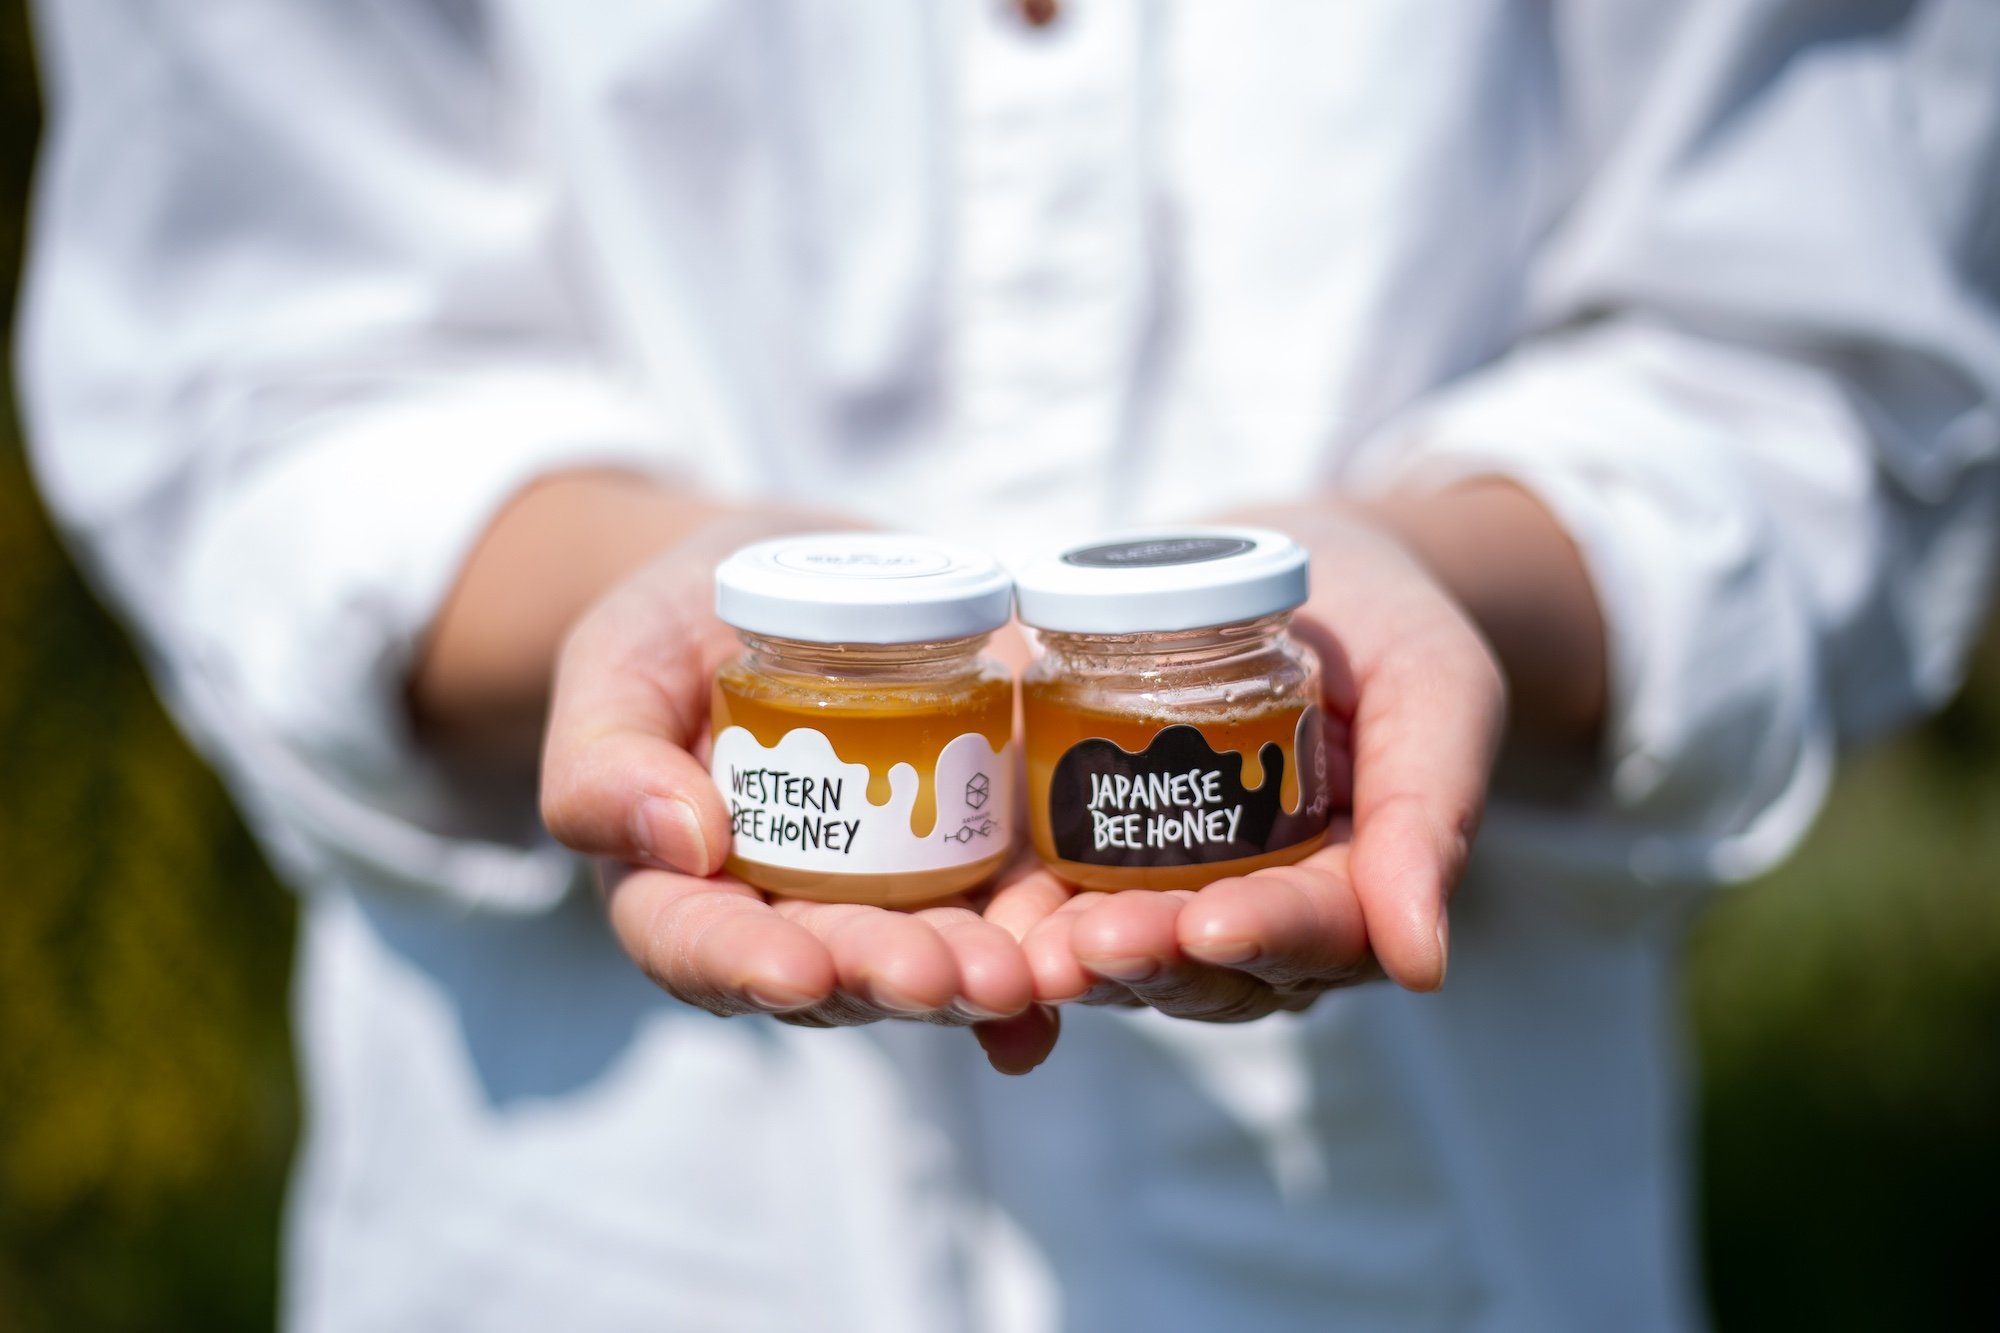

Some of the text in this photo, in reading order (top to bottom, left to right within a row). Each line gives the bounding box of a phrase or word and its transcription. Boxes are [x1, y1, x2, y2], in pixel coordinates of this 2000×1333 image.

[731, 764, 843, 813] WESTERN
[1087, 768, 1222, 811] JAPANESE
[731, 799, 861, 854] BEE HONEY
[1091, 804, 1243, 851] BEE HONEY
